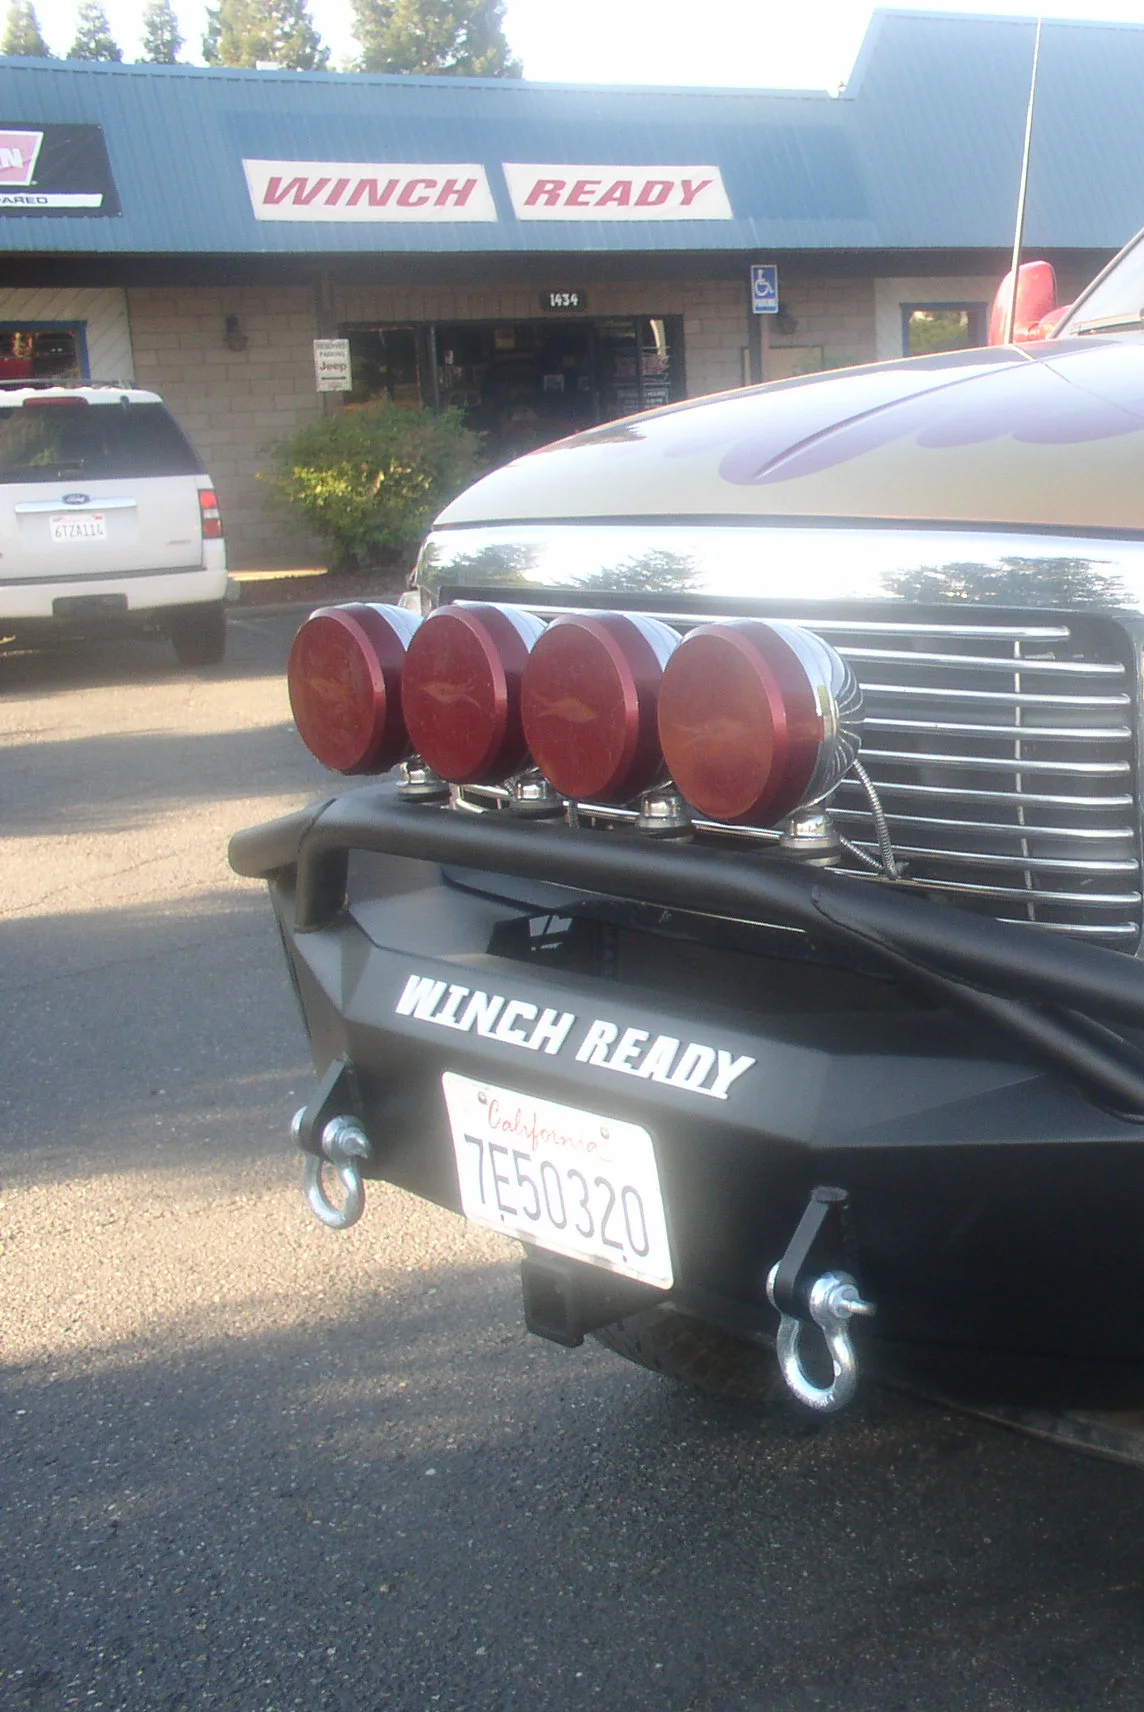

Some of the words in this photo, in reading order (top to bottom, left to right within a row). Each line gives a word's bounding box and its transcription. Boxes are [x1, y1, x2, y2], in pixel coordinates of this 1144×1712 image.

[0, 196, 49, 204] ARED
[262, 176, 477, 207] WINCH
[523, 179, 714, 207] READY
[550, 293, 578, 307] 1434
[395, 974, 577, 1055] WINCH
[575, 1019, 756, 1100] READY
[487, 1099, 609, 1158] California
[464, 1133, 650, 1258] 7E50320
